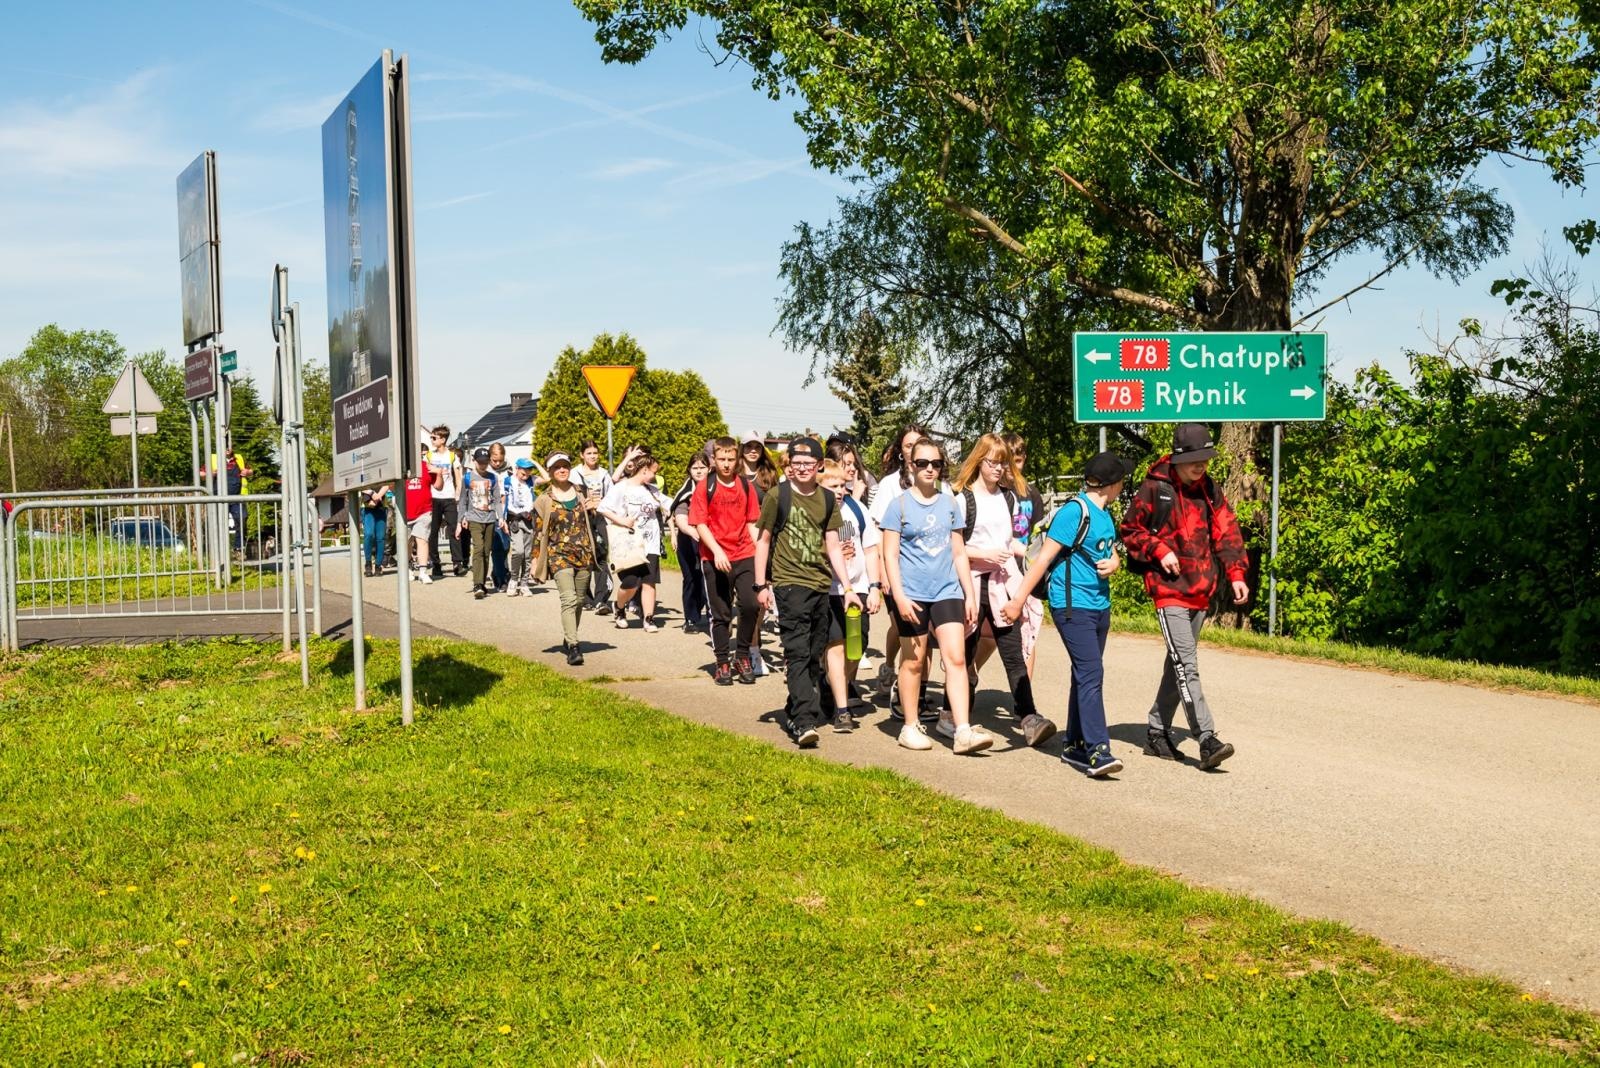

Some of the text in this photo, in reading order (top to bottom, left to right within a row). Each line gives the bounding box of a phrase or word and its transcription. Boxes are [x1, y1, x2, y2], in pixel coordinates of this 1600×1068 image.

[1132, 344, 1303, 375] 78 Chałupki
[1107, 381, 1246, 412] 78 Rybnik
